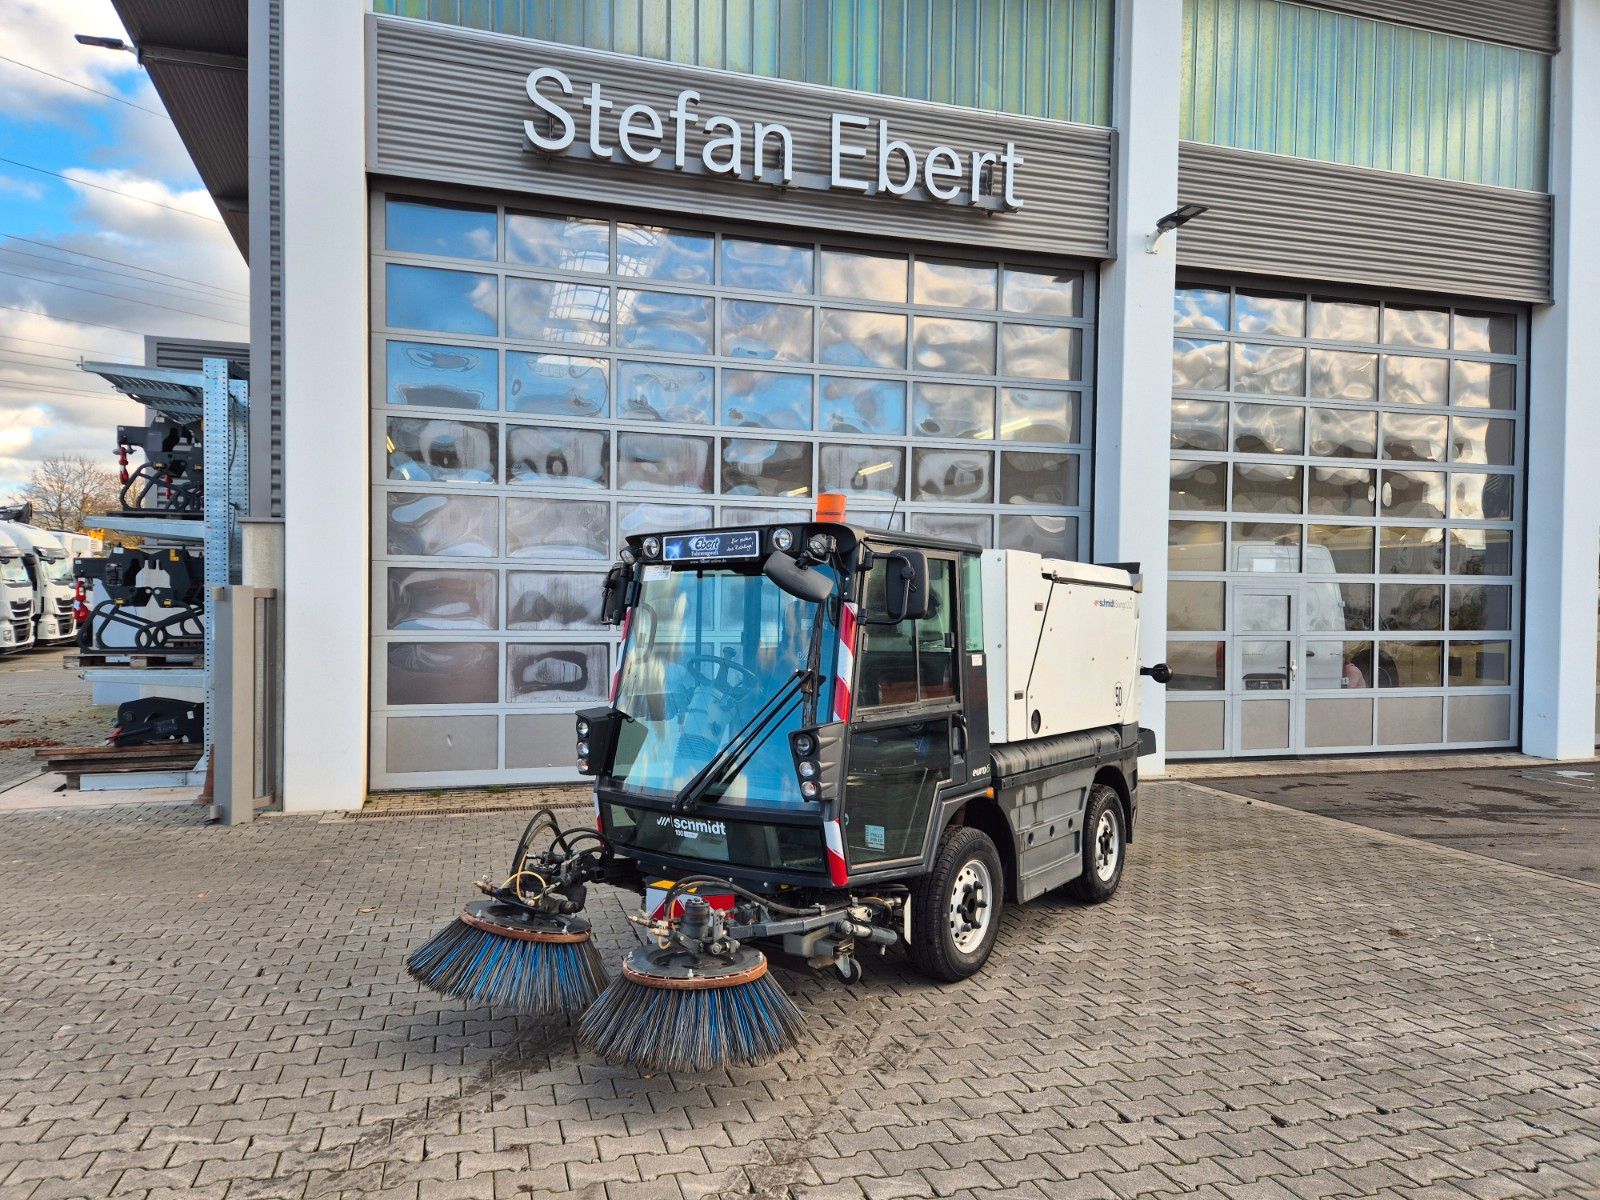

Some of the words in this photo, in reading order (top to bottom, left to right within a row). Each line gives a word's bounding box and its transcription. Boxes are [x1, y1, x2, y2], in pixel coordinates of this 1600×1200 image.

[523, 67, 793, 183] Stefan
[830, 113, 1024, 208] Ebert
[694, 536, 720, 550] Ebert
[673, 818, 727, 835] schmidt
